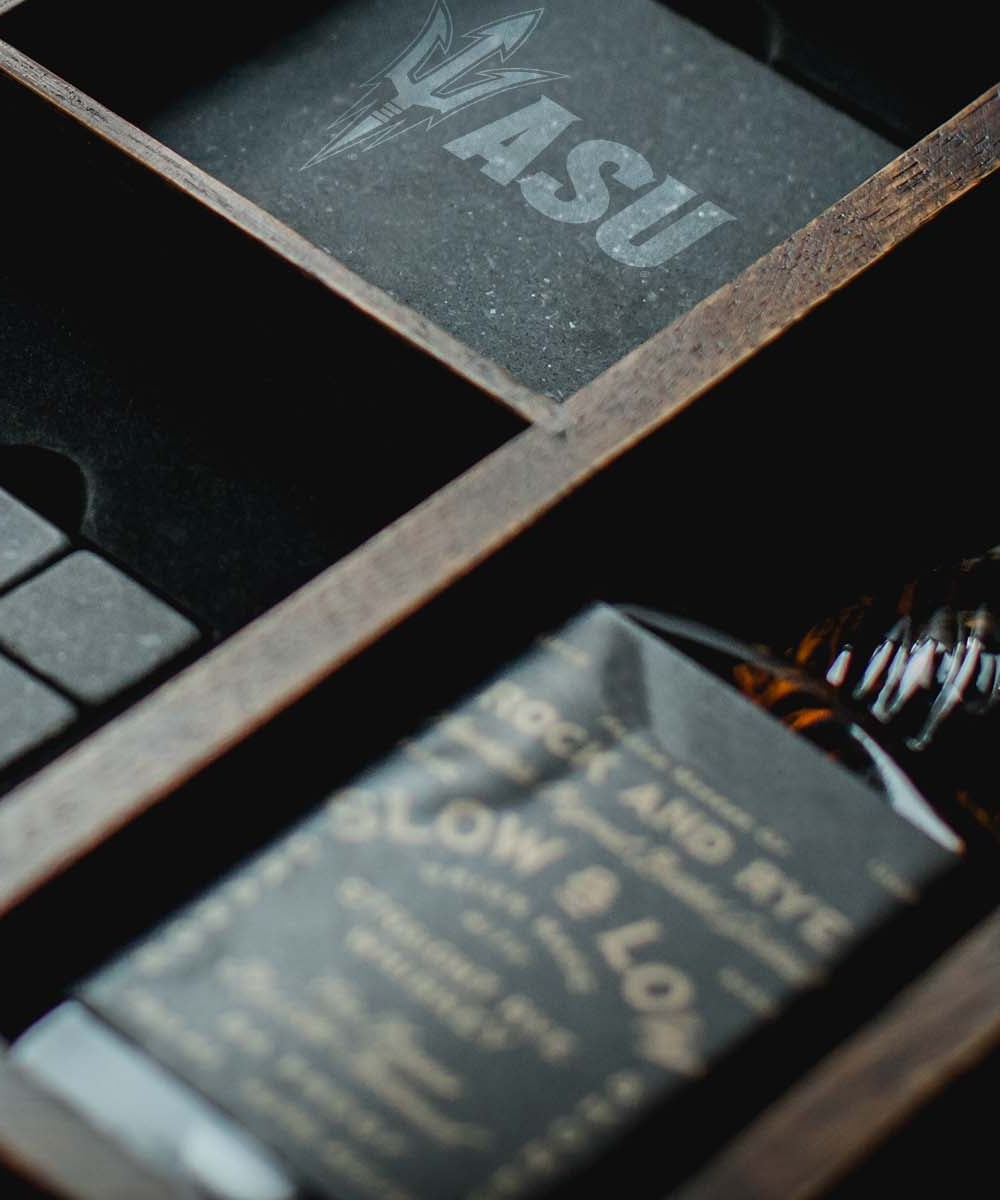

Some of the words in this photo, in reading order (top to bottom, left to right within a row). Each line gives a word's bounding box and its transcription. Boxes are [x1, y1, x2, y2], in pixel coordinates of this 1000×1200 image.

[442, 94, 738, 269] ASU
[618, 781, 737, 867] AND
[733, 857, 856, 955] RYE
